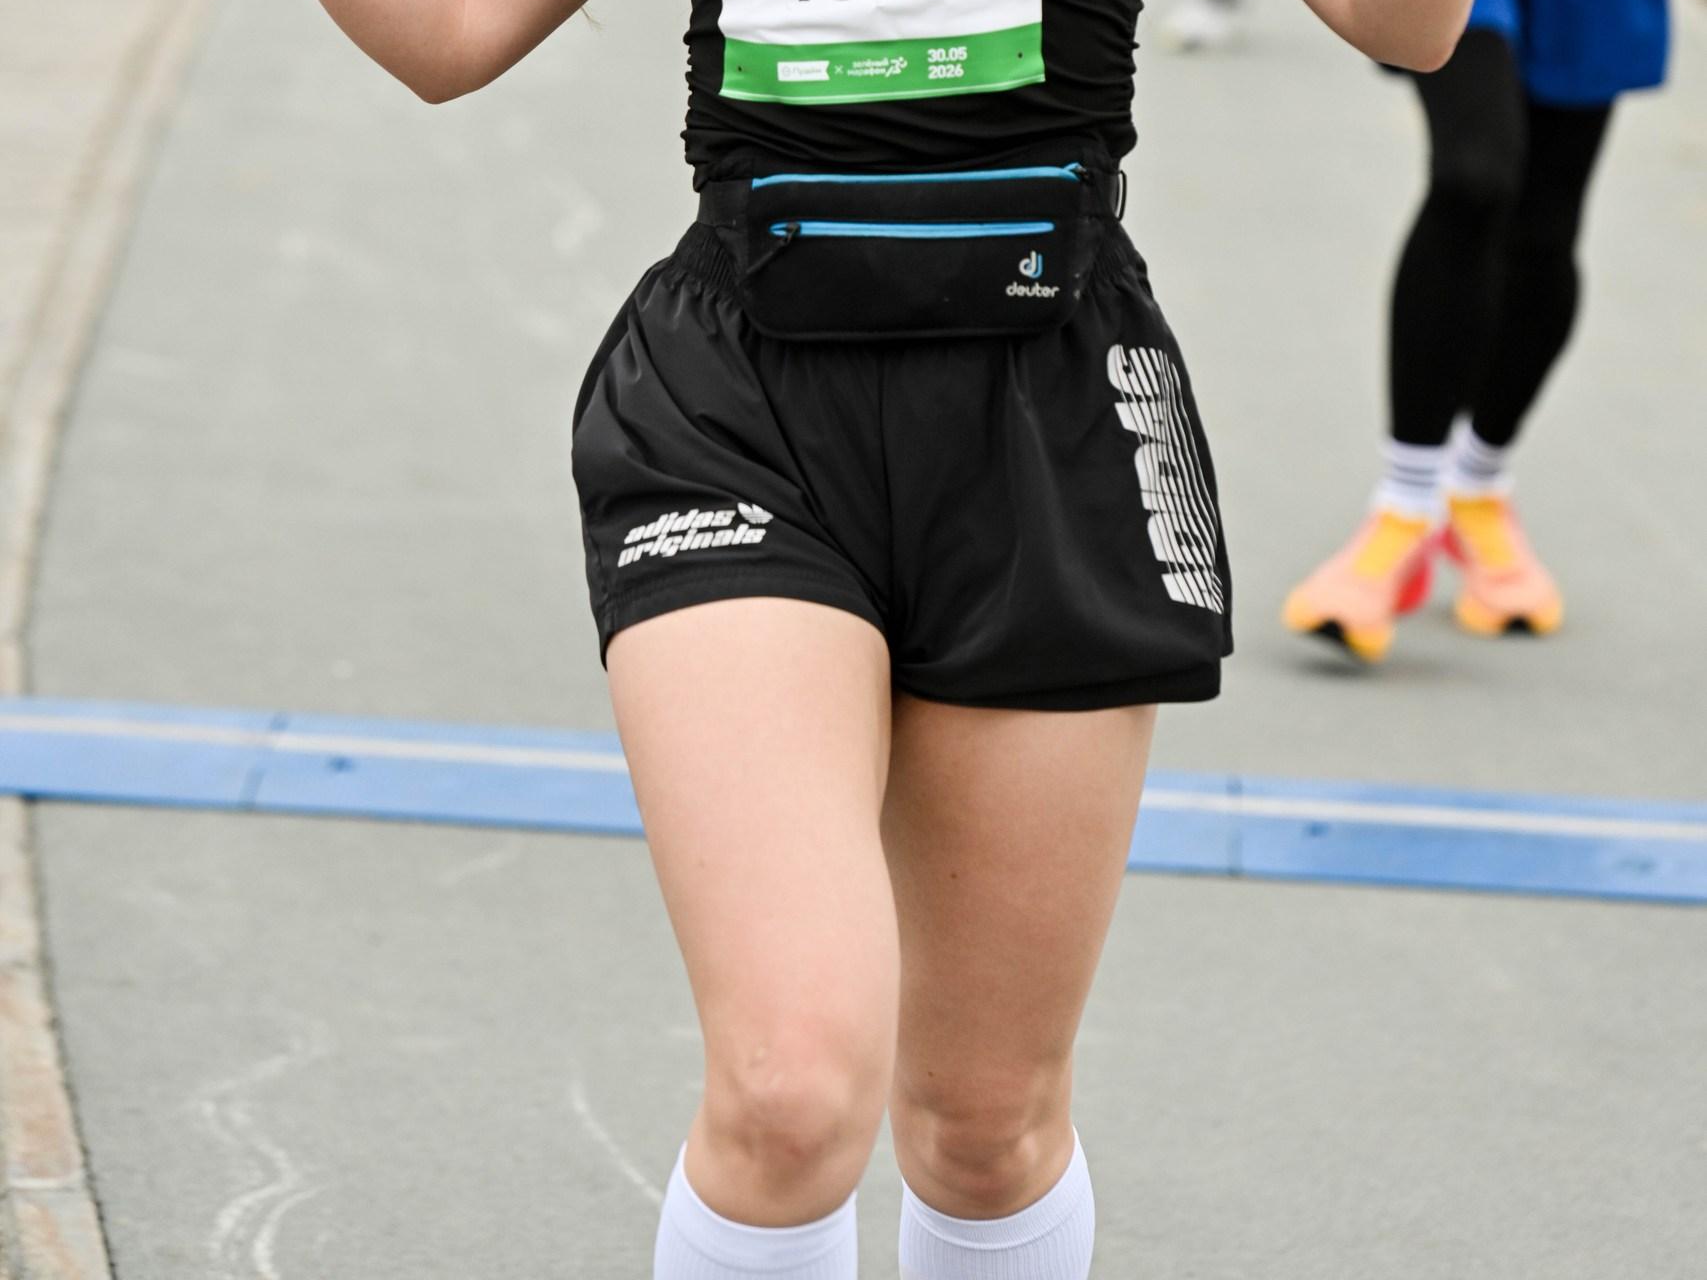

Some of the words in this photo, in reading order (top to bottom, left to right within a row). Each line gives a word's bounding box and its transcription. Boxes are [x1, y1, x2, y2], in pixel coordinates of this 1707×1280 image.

[926, 46, 967, 63] 30.05
[927, 63, 964, 80] 2026
[1005, 281, 1060, 298] deuter
[624, 508, 737, 545] adidas
[617, 523, 767, 568] originals
